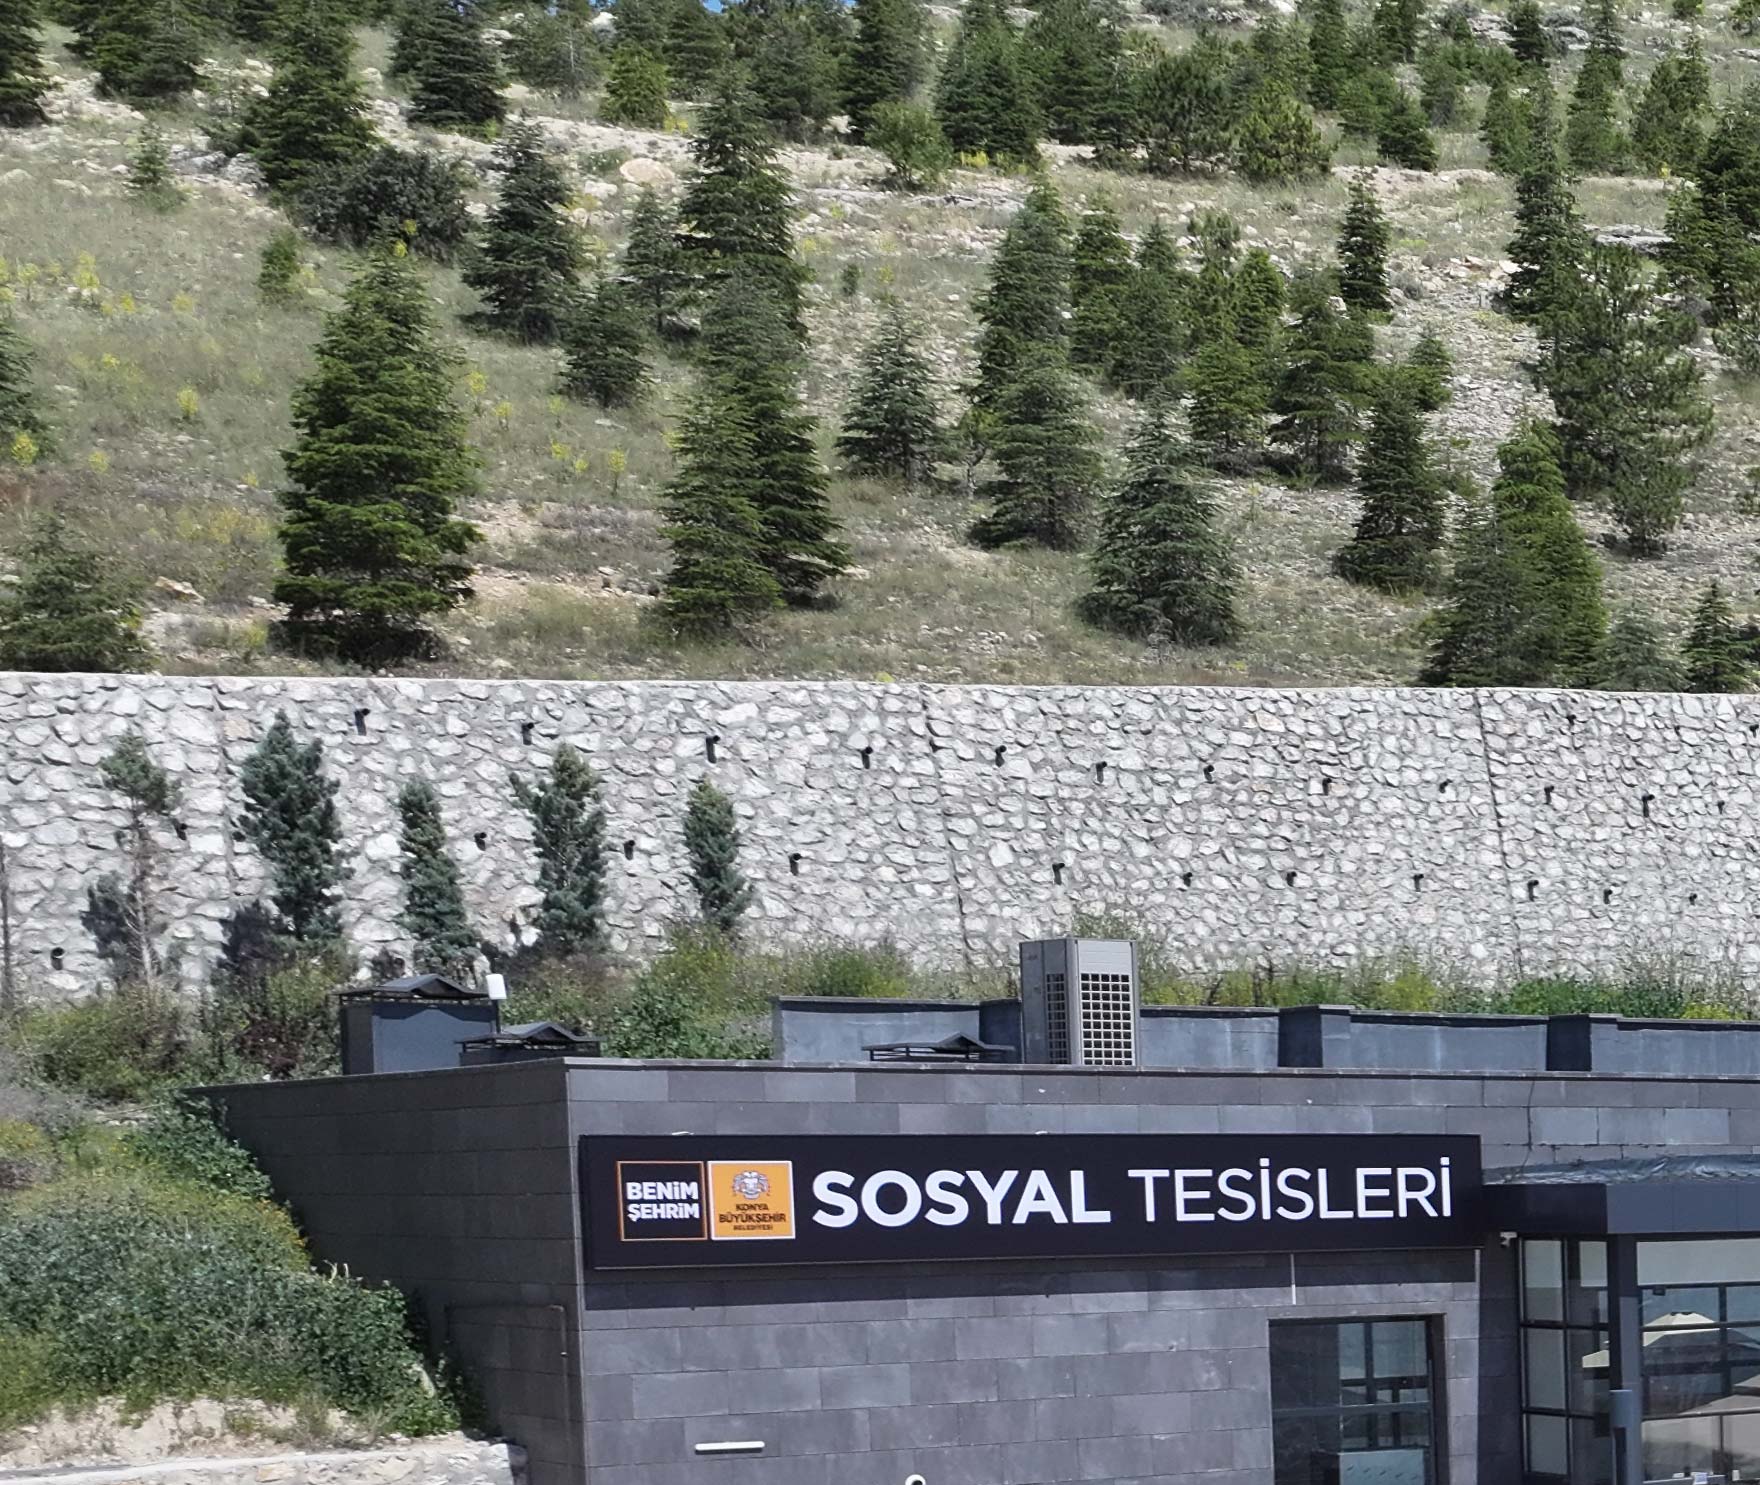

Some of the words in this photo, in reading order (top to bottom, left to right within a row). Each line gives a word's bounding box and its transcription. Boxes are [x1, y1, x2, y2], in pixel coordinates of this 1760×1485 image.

[625, 1181, 699, 1201] BENİM
[812, 1169, 1112, 1227] SOSYAL
[1127, 1157, 1452, 1222] TESİSLERİ
[627, 1203, 700, 1222] ŞEHRİM
